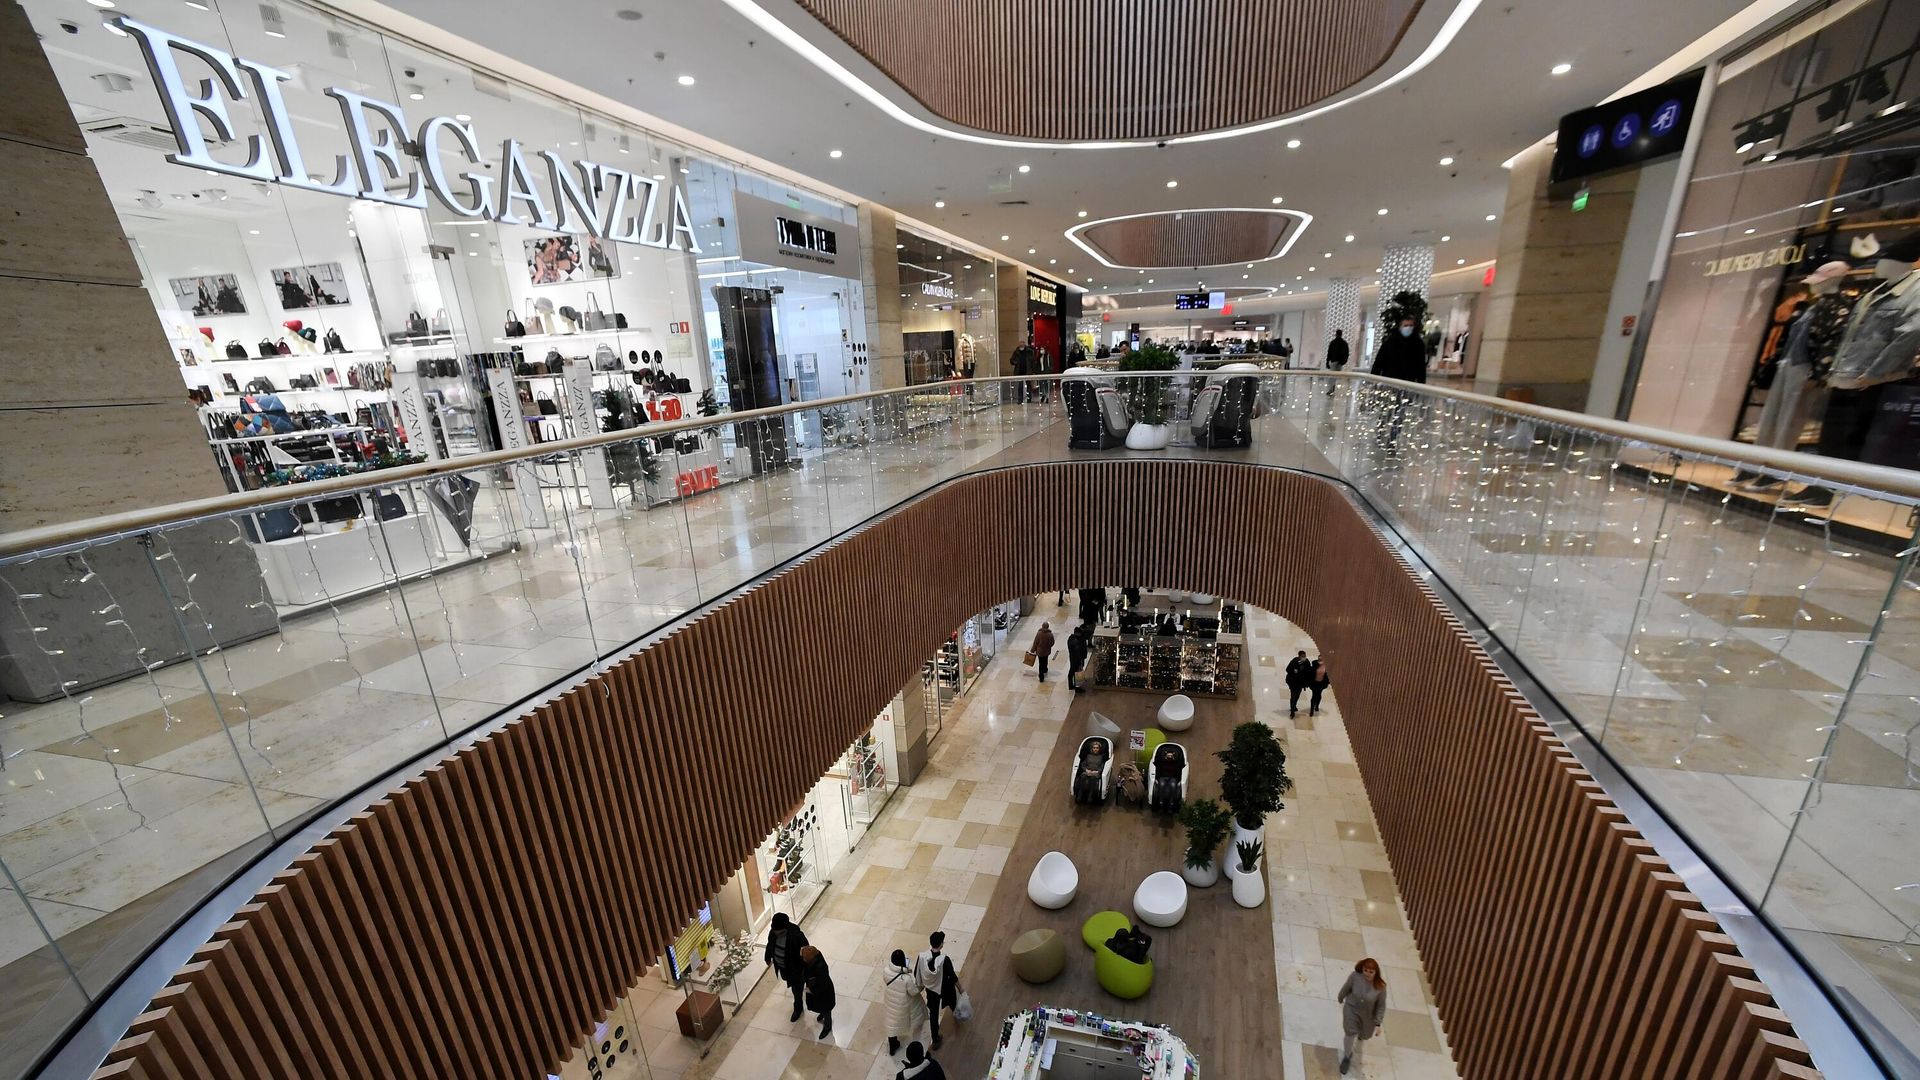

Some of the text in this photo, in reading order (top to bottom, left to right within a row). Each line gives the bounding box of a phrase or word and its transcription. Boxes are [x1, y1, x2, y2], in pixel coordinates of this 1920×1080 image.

[112, 16, 702, 254] ELEGANZZA
[402, 387, 426, 453] GANZZA
[497, 381, 519, 449] EGANZZA
